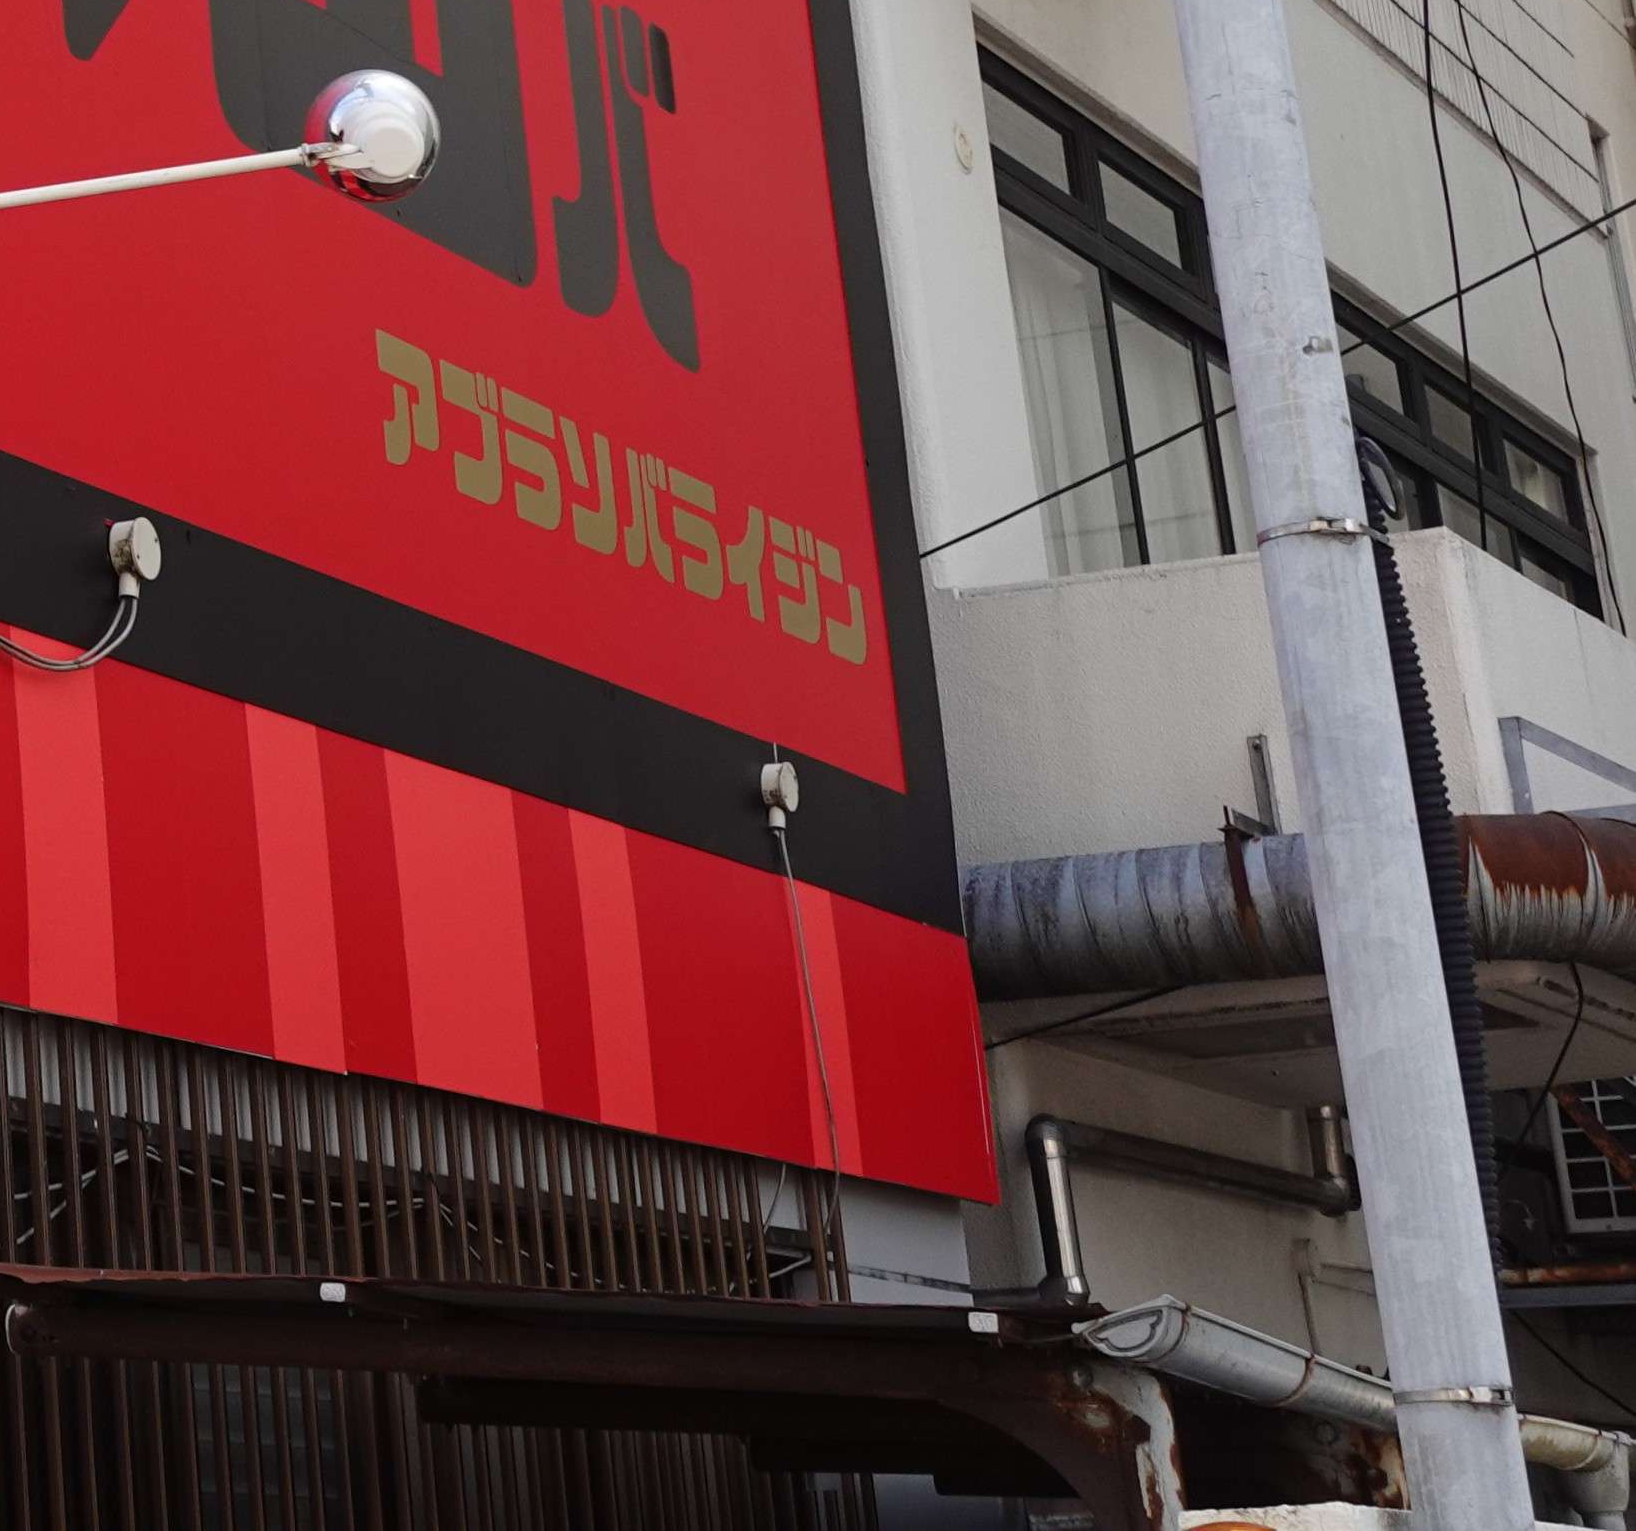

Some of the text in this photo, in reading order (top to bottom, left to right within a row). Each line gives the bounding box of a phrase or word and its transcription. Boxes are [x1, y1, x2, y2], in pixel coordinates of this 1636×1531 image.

[374, 328, 869, 665] アブラソバライジン
